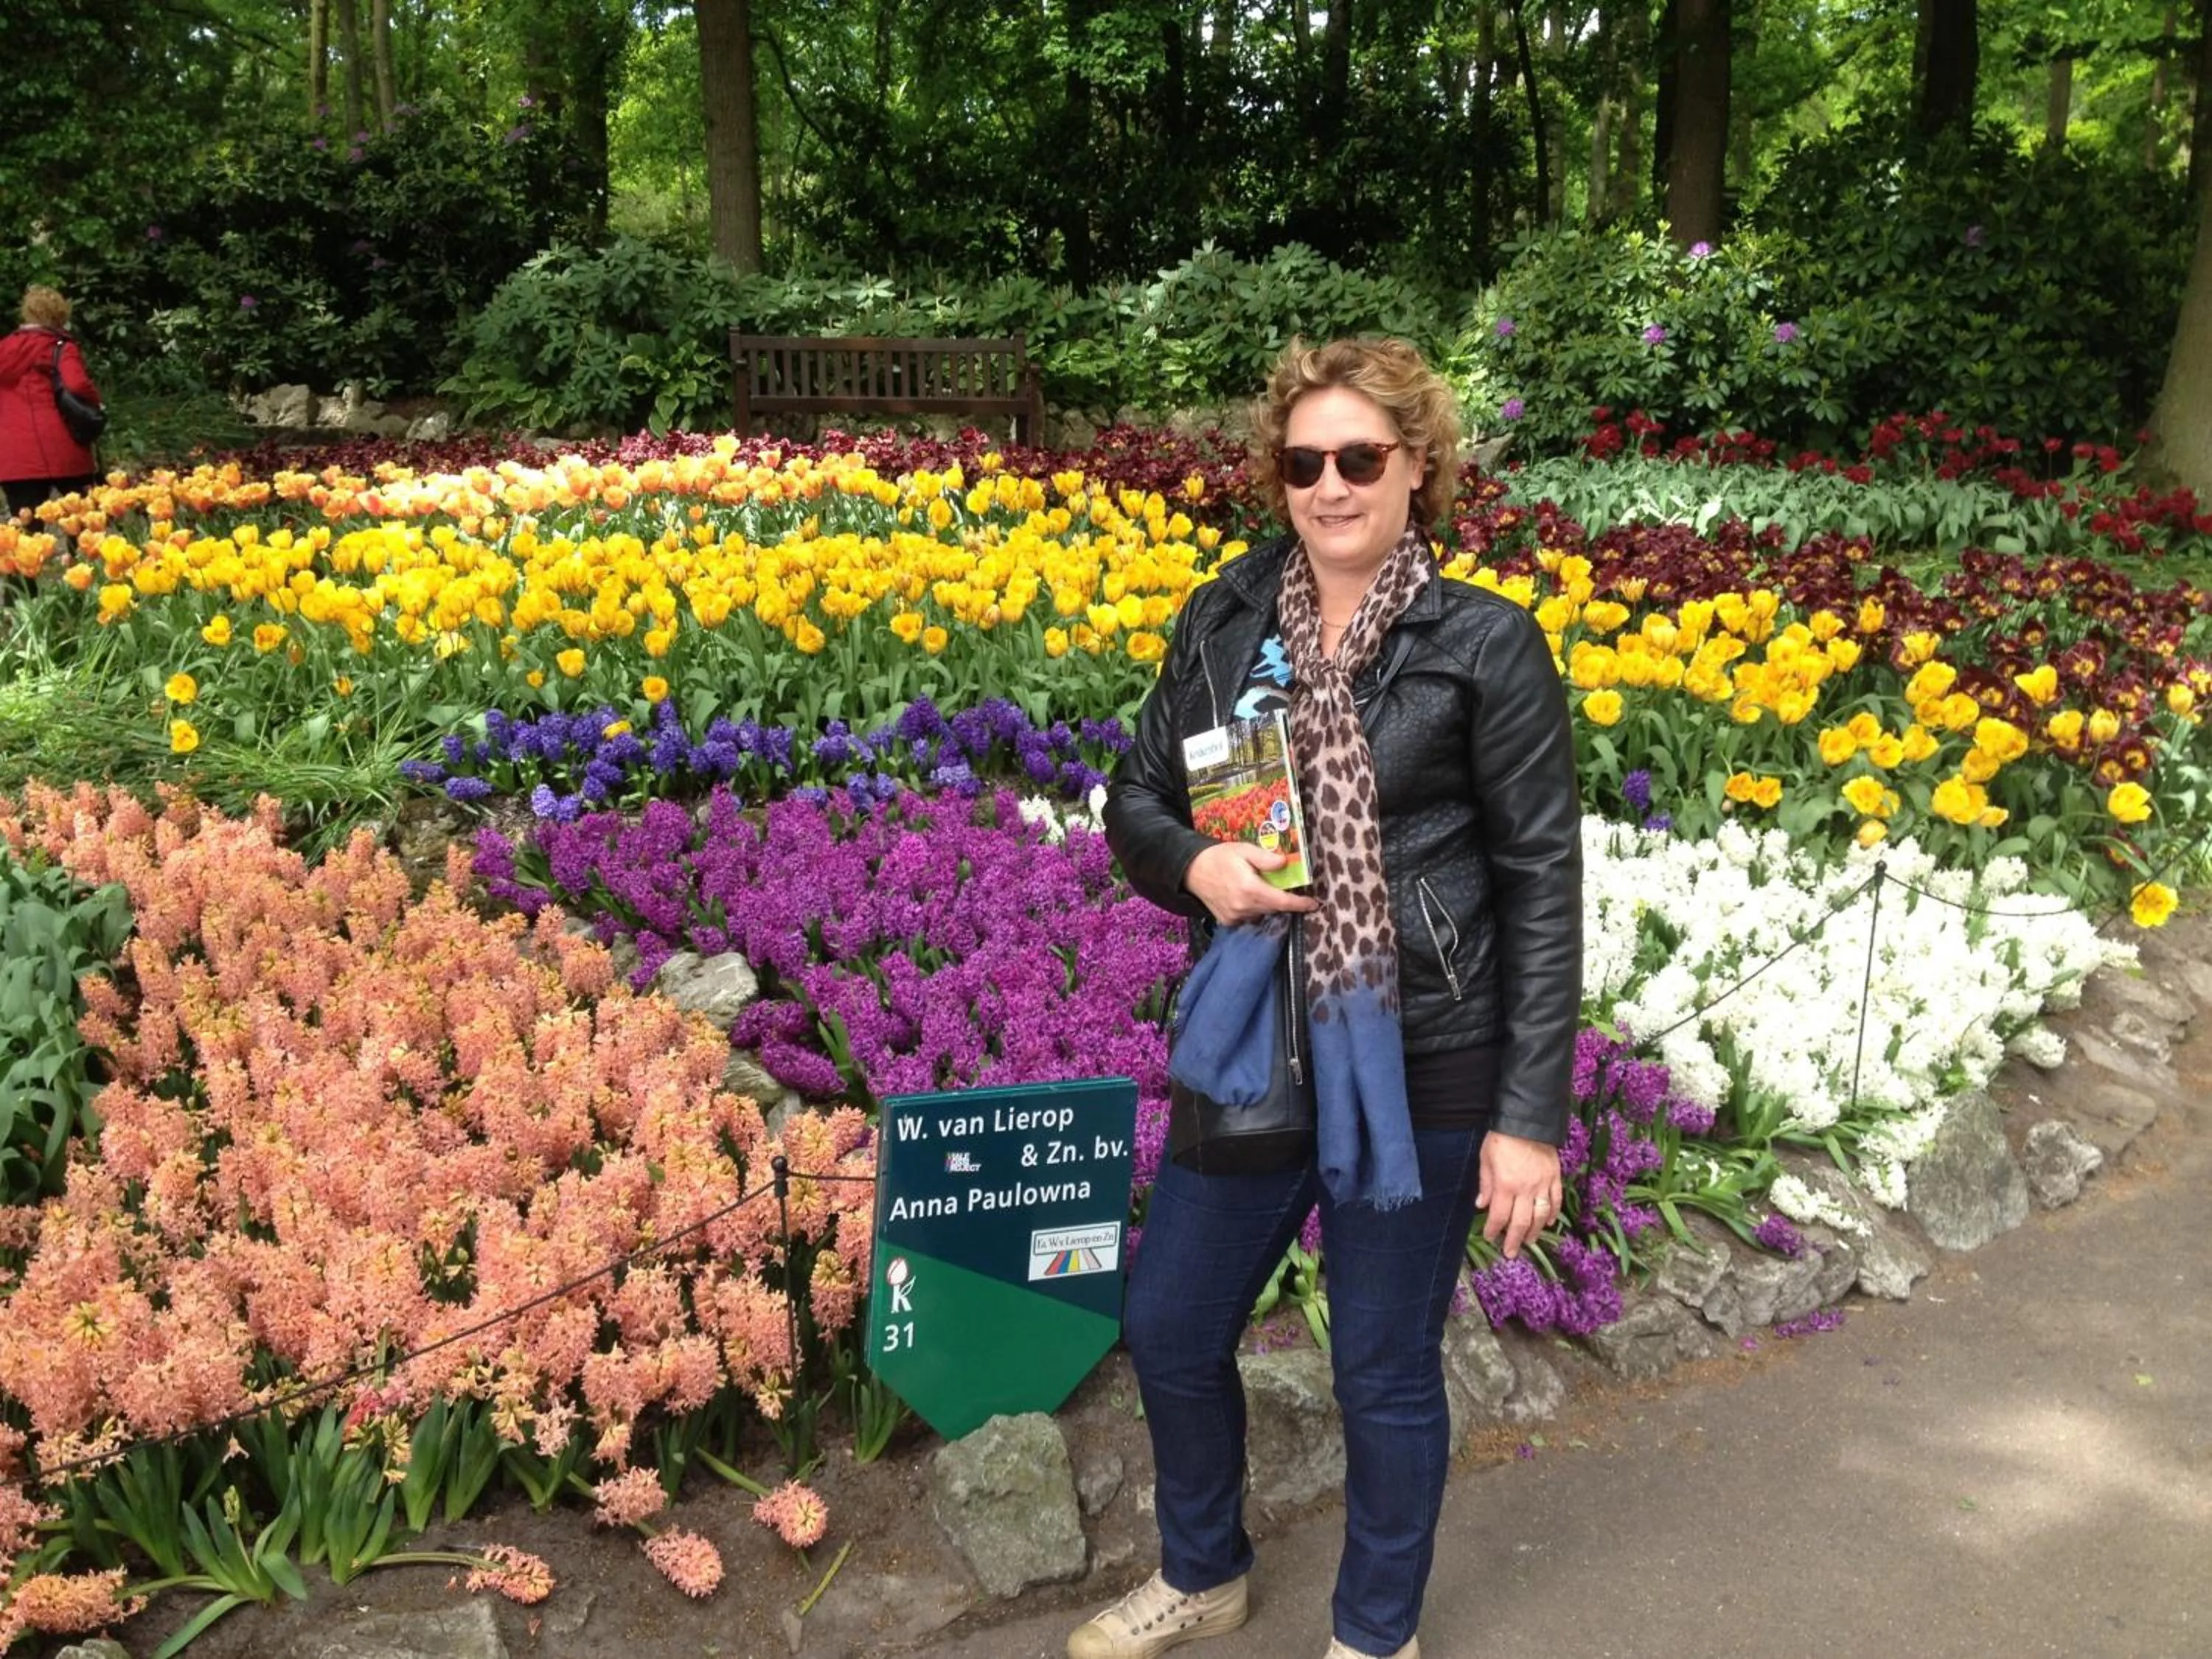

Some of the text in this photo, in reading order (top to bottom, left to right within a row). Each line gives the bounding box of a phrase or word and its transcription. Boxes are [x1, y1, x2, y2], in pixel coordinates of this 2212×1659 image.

[897, 1106, 1074, 1141] W. van Lierop
[1020, 1135, 1128, 1167] & Zn. bv.
[888, 1180, 1091, 1222] Anna Paulowna
[883, 1321, 914, 1352] 31
